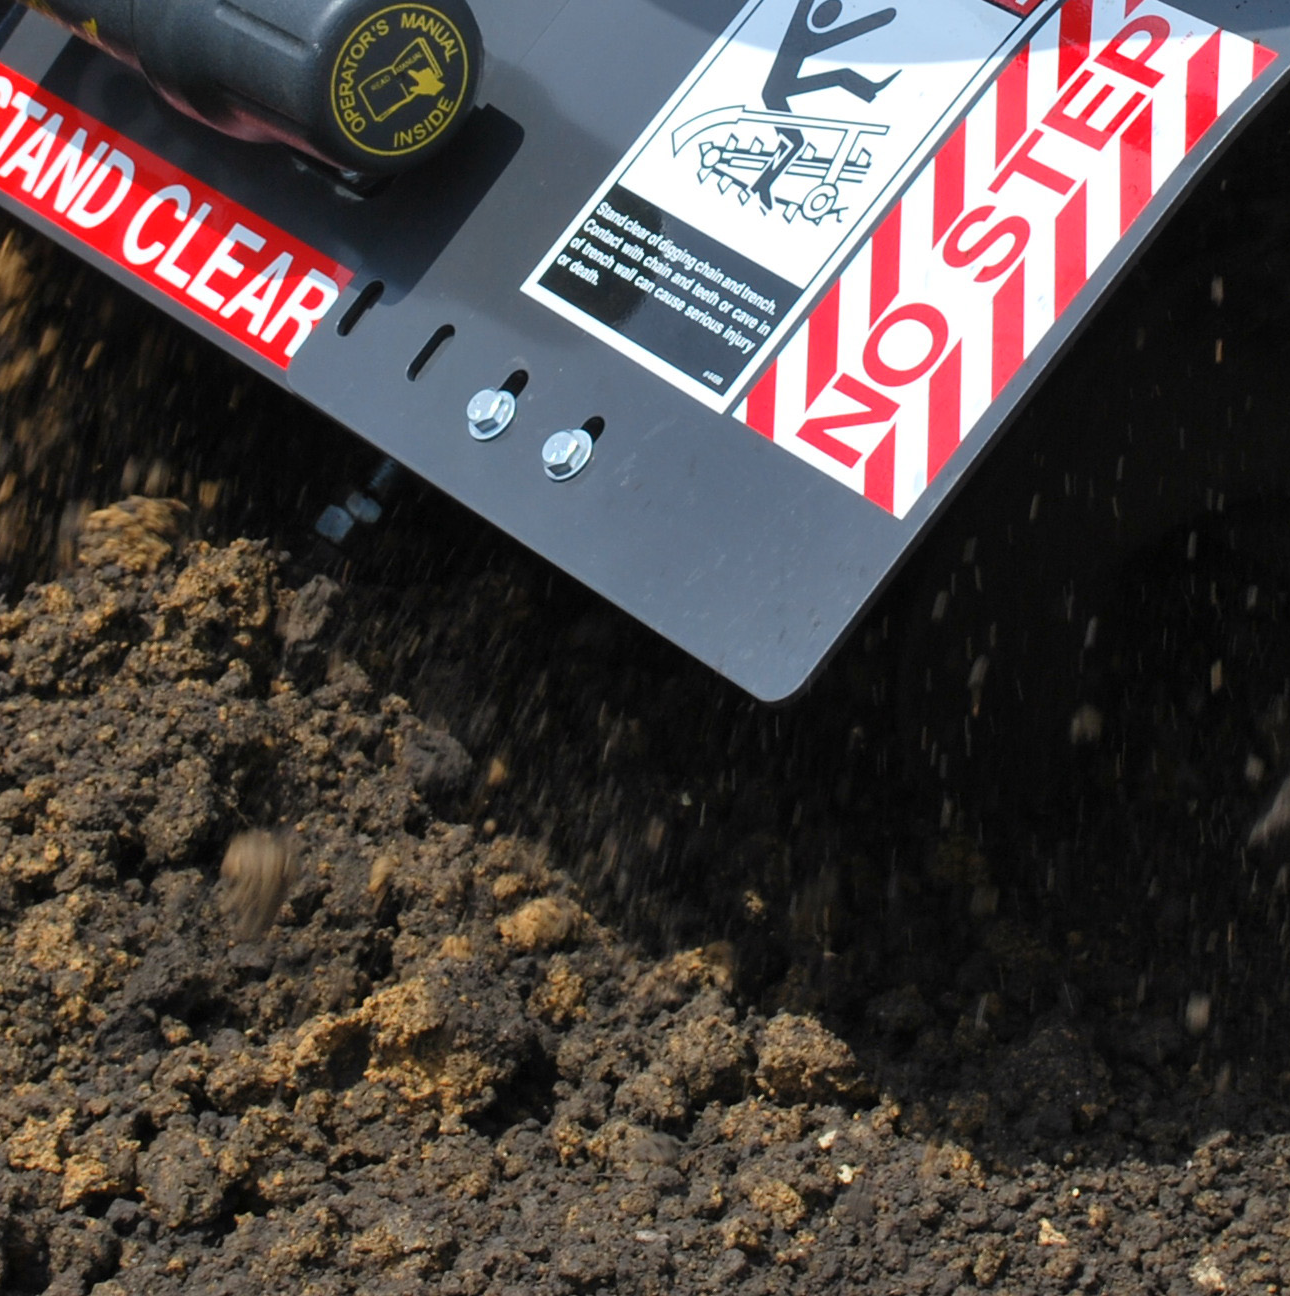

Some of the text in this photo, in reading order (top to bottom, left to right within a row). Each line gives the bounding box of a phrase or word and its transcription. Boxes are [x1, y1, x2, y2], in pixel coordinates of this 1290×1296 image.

[339, 12, 459, 133] OPERATOR'S MANUAL
[393, 96, 455, 148] INSIDE
[122, 184, 339, 357] CLEAR
[557, 254, 598, 285] or death.
[570, 238, 755, 354] of trench wall can cause serious injury
[584, 219, 771, 336] Contact with chain and teeth or cave in
[596, 202, 775, 315] Stand clear of digging chain and trench.
[795, 15, 1171, 469] NO STEP
